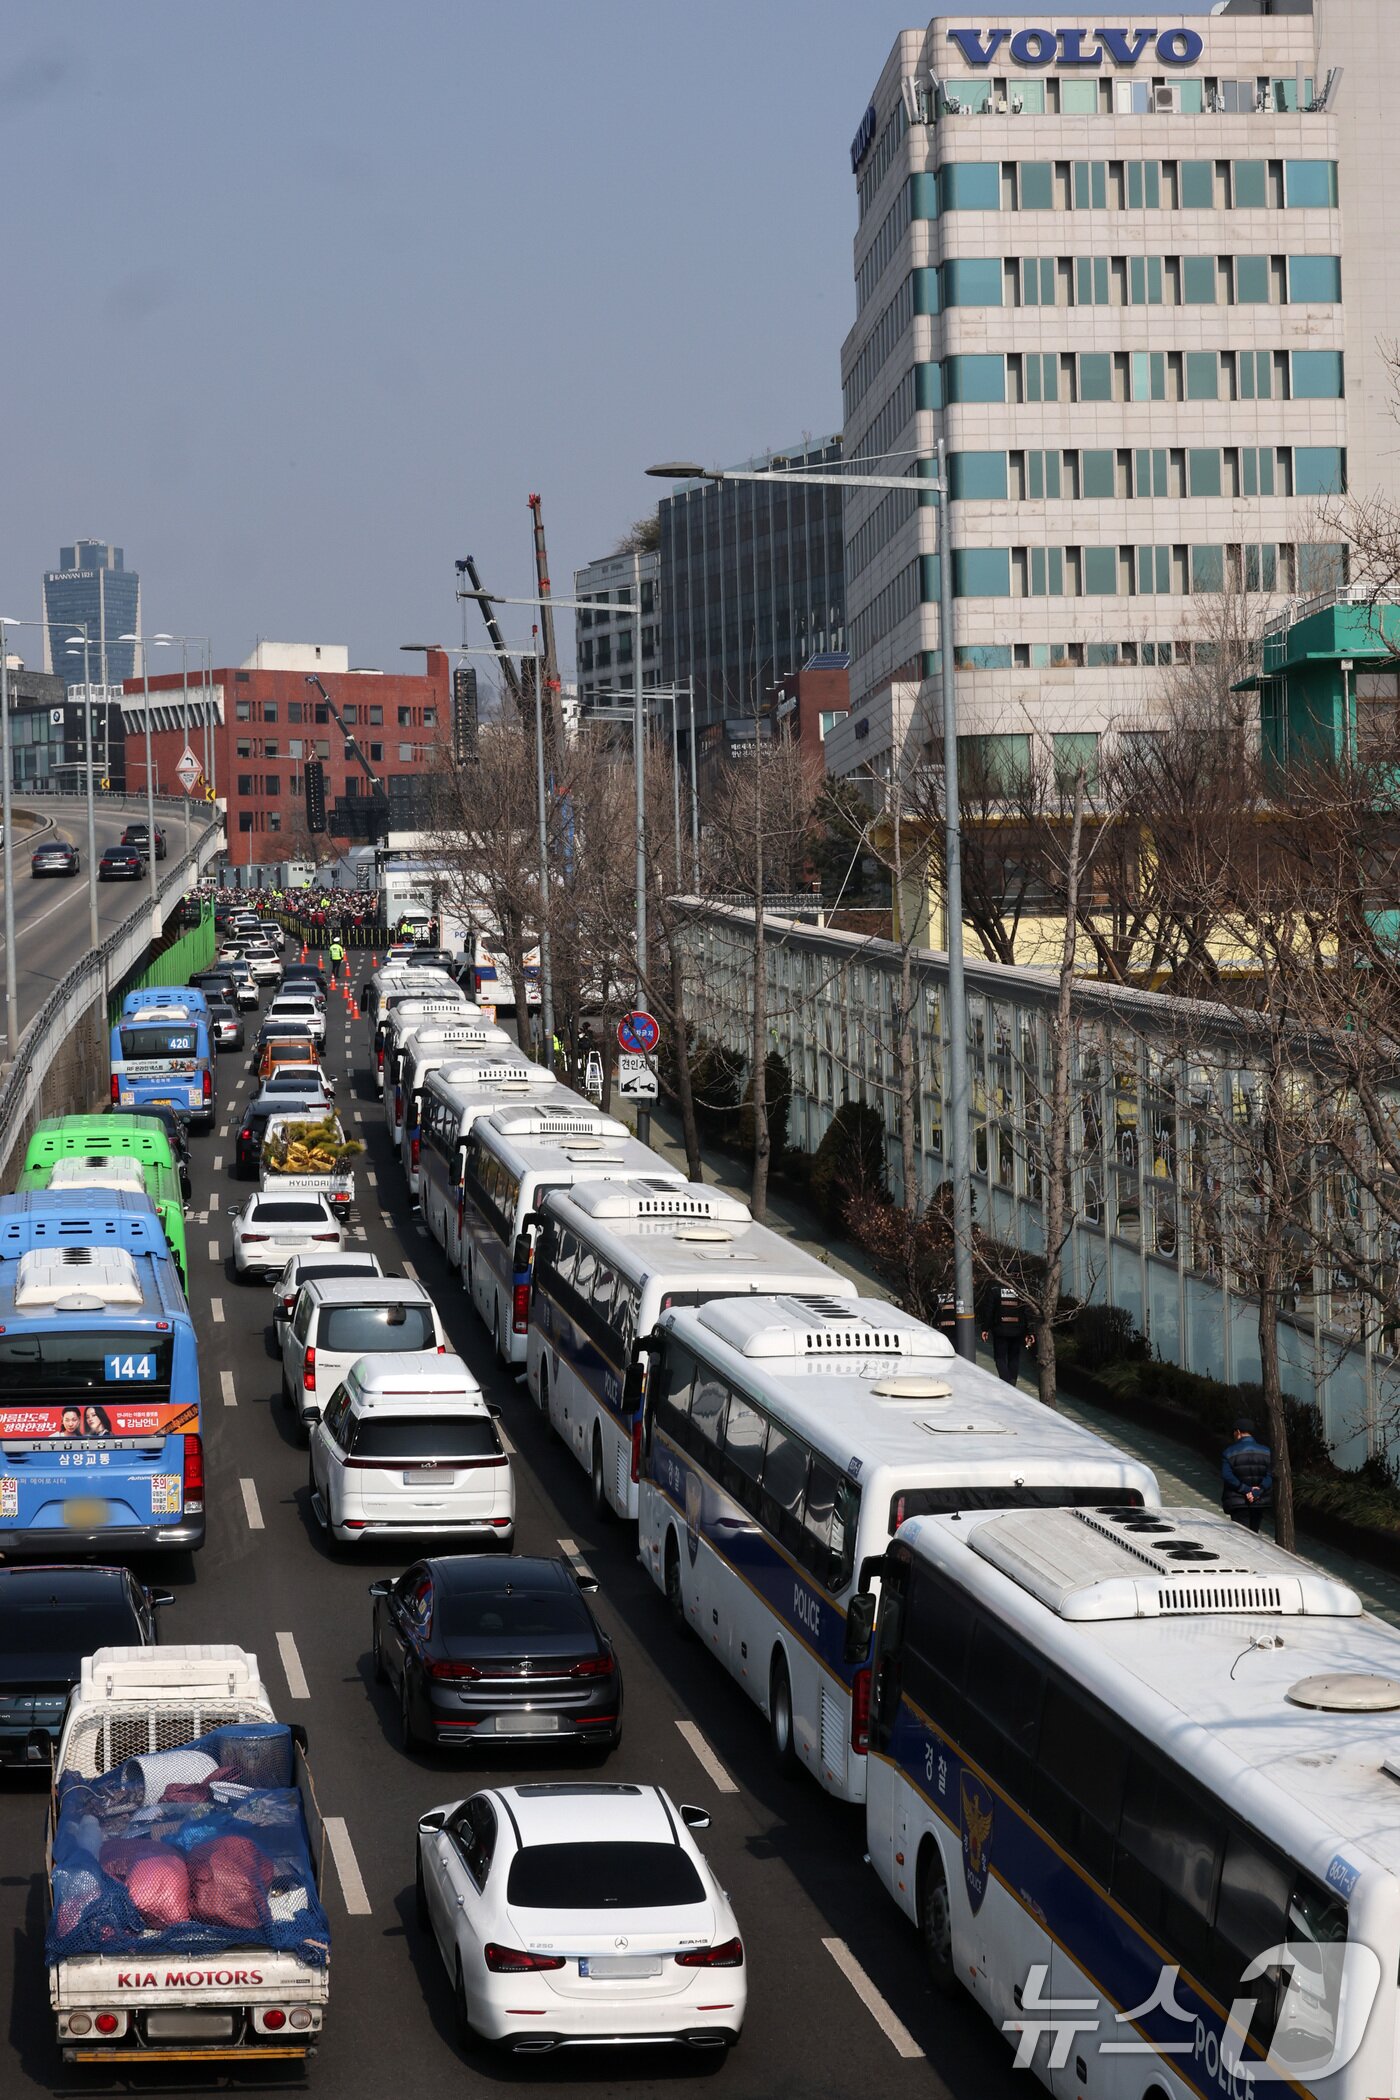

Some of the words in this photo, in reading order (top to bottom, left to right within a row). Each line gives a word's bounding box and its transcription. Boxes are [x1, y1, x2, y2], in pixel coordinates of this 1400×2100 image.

[948, 28, 1203, 64] VOLVO
[170, 1039, 188, 1049] 420
[110, 1357, 151, 1379] 144
[127, 1418, 159, 1428] 강남언니
[33, 1440, 136, 1450] HYUNDAI
[59, 1453, 111, 1466] 삼양교통
[152, 1478, 167, 1490] 주의
[668, 1459, 680, 1493] 경찰
[2, 1481, 17, 1493] 주의
[793, 1583, 821, 1637] POLICE
[925, 1743, 947, 1796] 경찰
[967, 1867, 982, 1895] POLICE
[118, 1972, 158, 1988] KIA
[165, 1969, 264, 1987] MOTORS
[1195, 2016, 1255, 2100] POLICE
